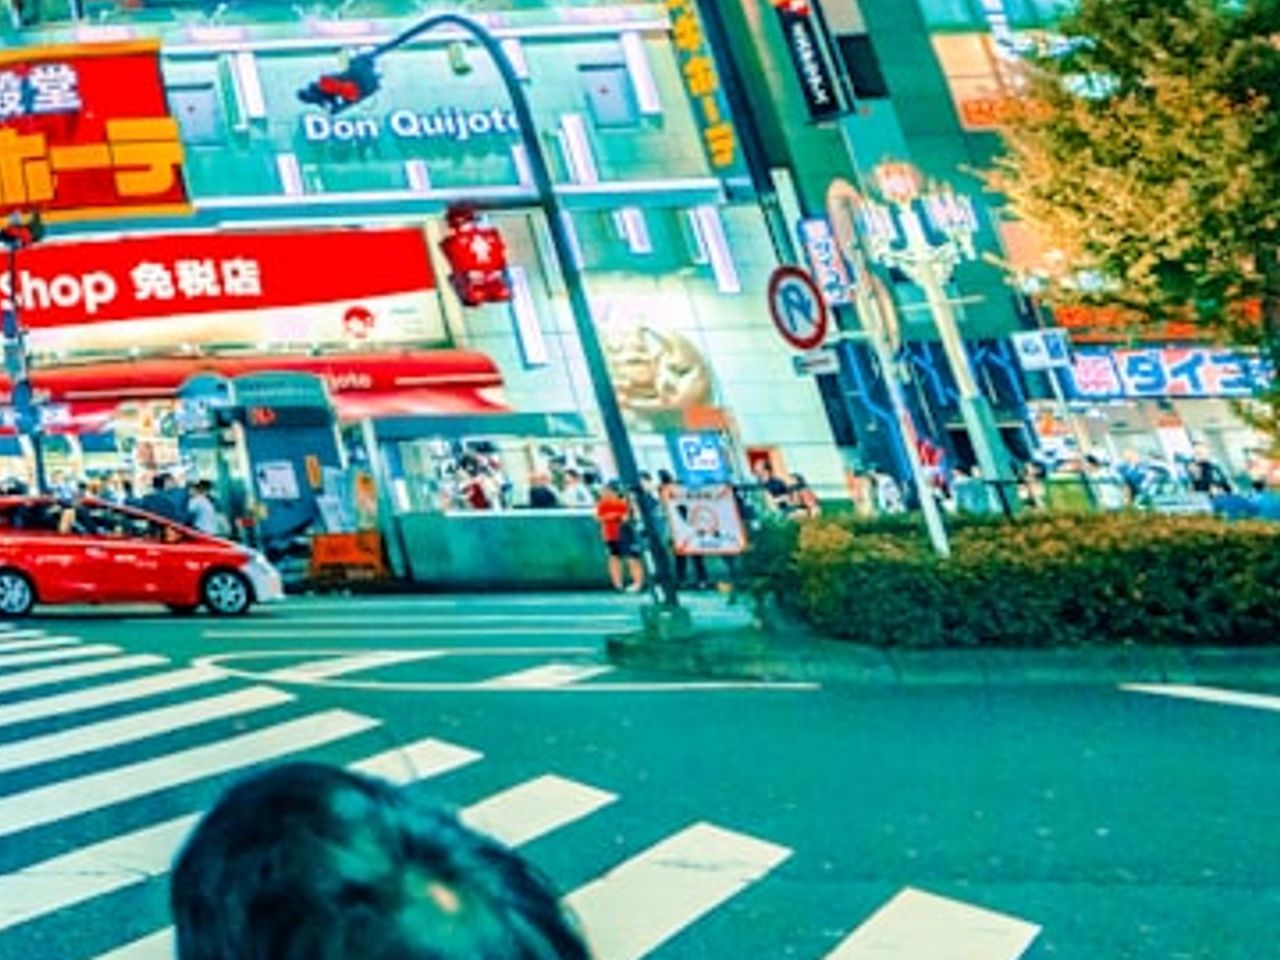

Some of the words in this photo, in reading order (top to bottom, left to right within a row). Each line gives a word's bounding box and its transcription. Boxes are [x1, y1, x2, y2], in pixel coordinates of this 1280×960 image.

[303, 112, 379, 141] Don
[130, 257, 264, 300] 免税店
